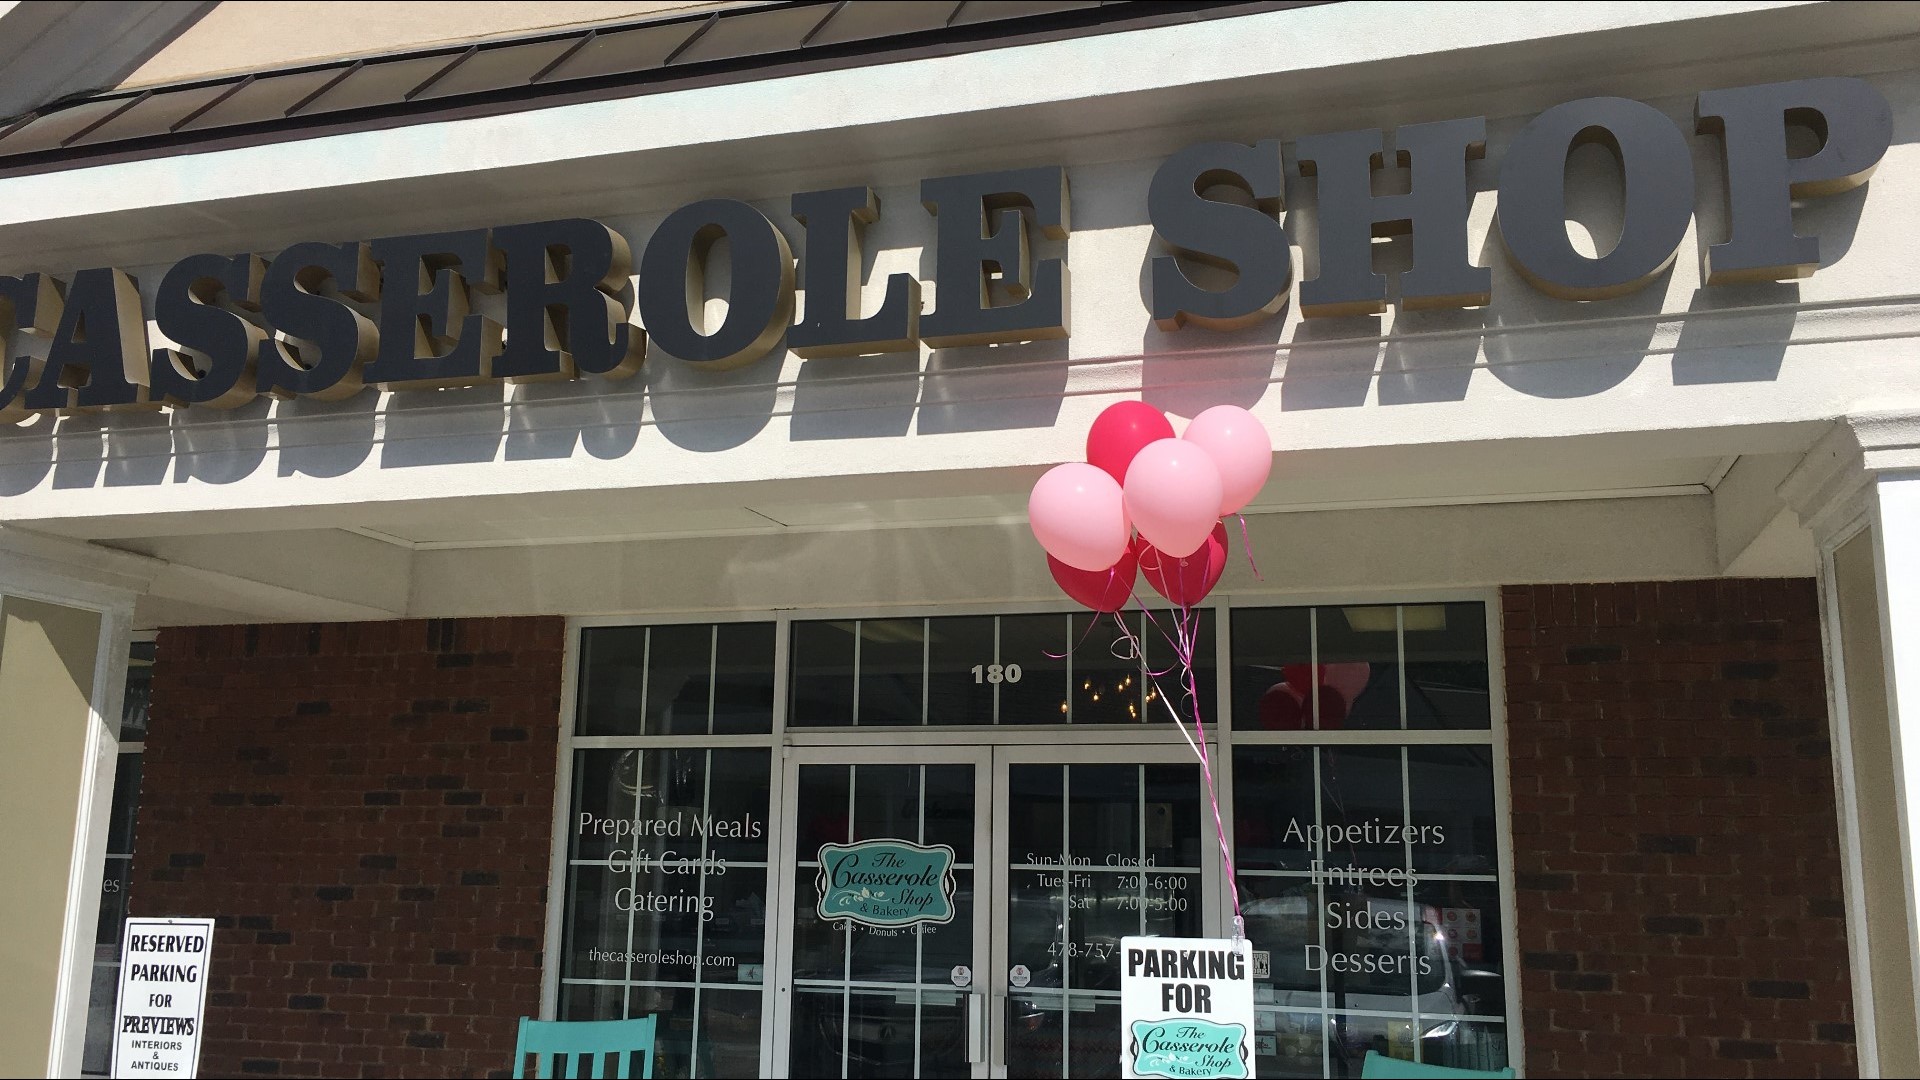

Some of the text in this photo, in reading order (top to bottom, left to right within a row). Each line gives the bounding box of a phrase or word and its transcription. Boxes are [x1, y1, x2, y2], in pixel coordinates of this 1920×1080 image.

[1148, 76, 1893, 328] SHOP
[971, 663, 1022, 684] 180
[579, 811, 762, 843] Prepared Meals
[1282, 816, 1445, 852] Appetizers
[608, 848, 726, 876] Gift Cards
[871, 852, 907, 868] The
[1026, 852, 1091, 868] Sun-Mon
[831, 853, 938, 889] Casserole
[1310, 859, 1418, 887] Entrees
[1036, 873, 1187, 890] Tues-Fri 7:00-6:00
[614, 886, 715, 922] Catering
[891, 887, 934, 912] Shop
[1069, 894, 1188, 912] Sat 7:00-5:00
[860, 902, 910, 918] & Bakery
[1326, 900, 1406, 930] Sides
[832, 921, 857, 932] Caks
[868, 927, 898, 937] Donuts
[910, 924, 937, 935] Cffee
[130, 934, 205, 953] RESERVED
[1047, 941, 1121, 958] 478-757-
[589, 946, 735, 970] thecasseroleshop.com
[1128, 948, 1245, 980] PARKING
[1304, 944, 1432, 975] Desserts
[130, 963, 198, 983] PARKING
[148, 993, 172, 1008] FOR
[1161, 983, 1212, 1014] FOR
[121, 1015, 195, 1036] PREVIEWS
[1176, 1026, 1206, 1039] The
[131, 1039, 183, 1051] INTERIORS
[1142, 1026, 1235, 1054] Casserole
[152, 1051, 160, 1060] &
[1194, 1054, 1232, 1073] Shop
[130, 1060, 179, 1072] ANTIQUES
[1169, 1064, 1212, 1076] & Bakery
